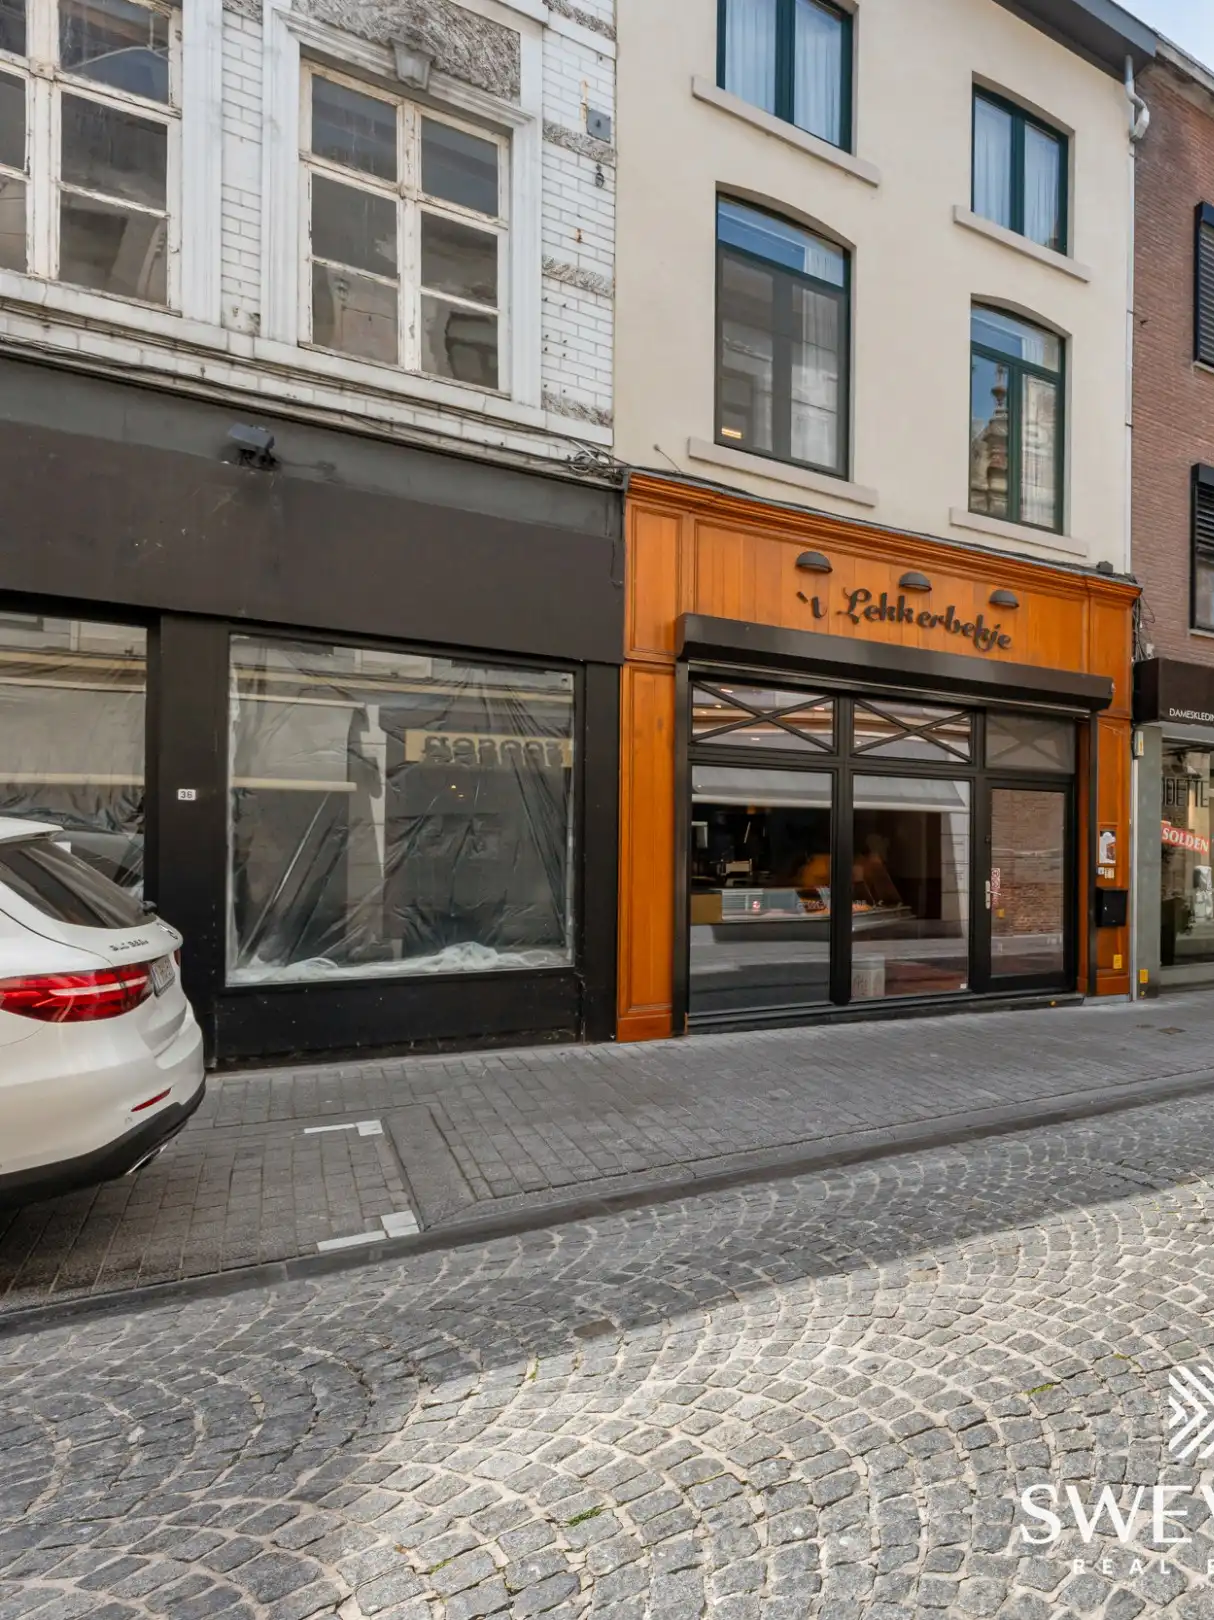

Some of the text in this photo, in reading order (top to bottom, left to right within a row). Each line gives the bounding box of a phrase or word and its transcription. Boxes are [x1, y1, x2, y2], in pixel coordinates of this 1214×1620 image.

[836, 587, 1012, 652] Lekkerbekje
[180, 790, 193, 799] 36
[1162, 827, 1209, 852] SOLDEN
